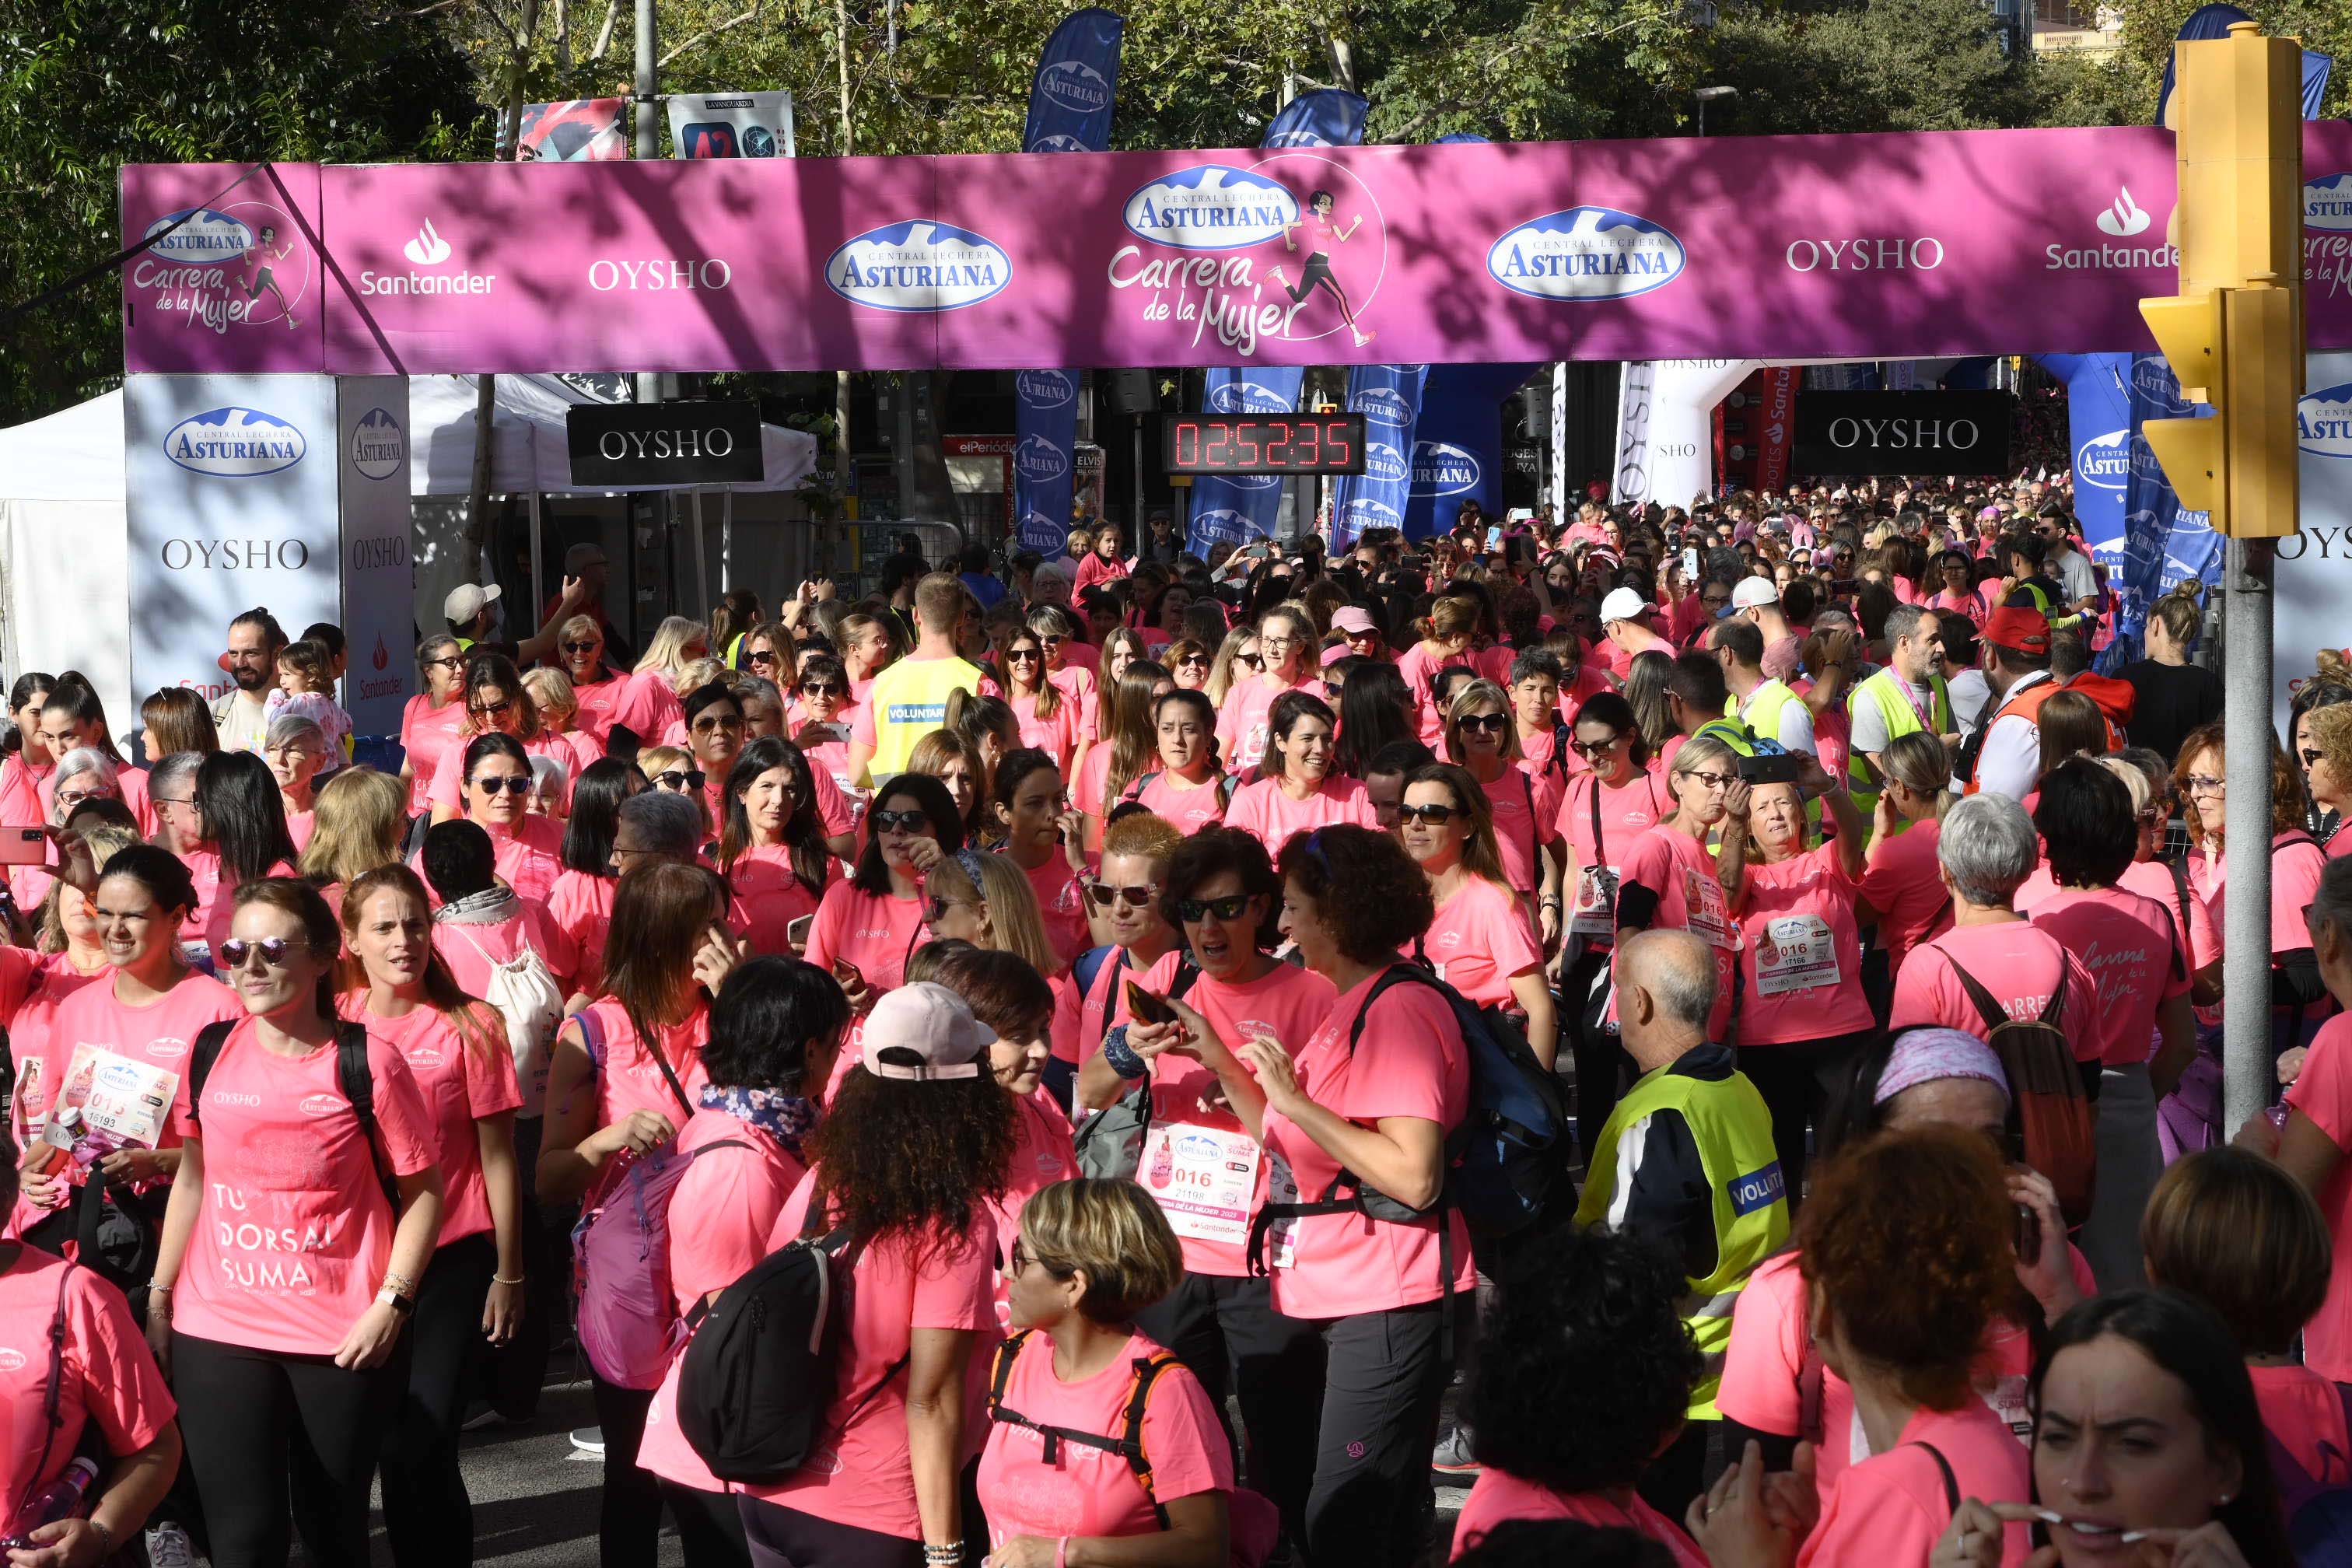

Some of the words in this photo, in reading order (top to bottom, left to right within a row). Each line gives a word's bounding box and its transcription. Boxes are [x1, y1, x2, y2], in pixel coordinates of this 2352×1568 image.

[1163, 194, 1220, 204] CENTRAL
[1224, 193, 1281, 202] LECHERA
[1137, 197, 1286, 229] ASTURIANA
[152, 229, 245, 250] ASTURIANA
[1533, 239, 1592, 250] CENTRAL
[1600, 236, 1664, 248] LECHERA
[868, 250, 927, 261] CENTRAL
[933, 250, 991, 261] LECHERA
[1502, 243, 1670, 278] ASTURIANA
[1787, 236, 1944, 271] OYSHO
[134, 260, 225, 289] Carrera
[588, 257, 732, 292] OYSHO
[841, 255, 998, 290] ASTURIANA
[1108, 245, 1254, 289] Carrera
[2317, 258, 2333, 281] la
[360, 270, 496, 296] Santander
[156, 290, 173, 310] de
[176, 290, 189, 310] la
[186, 285, 261, 335] Mujer
[1143, 289, 1171, 322] de
[1177, 289, 1196, 321] la
[1191, 278, 1309, 356] Mujer
[175, 433, 297, 460] ASTURIANA
[599, 427, 734, 460] OYSHO
[1176, 422, 1349, 465] 02:52:35
[1828, 417, 1979, 450] OYSHO
[355, 436, 401, 463] ASTURIANA
[1076, 456, 1102, 467] ELVIS
[1657, 443, 1696, 457] SHO
[161, 538, 310, 571] OYSHO
[352, 535, 405, 571] OYSHO
[359, 677, 404, 701] Santander
[1831, 747, 1845, 761] TU
[1703, 901, 1723, 916] 016
[1776, 926, 1805, 938] ASTURIANA
[1780, 943, 1808, 957] 016
[1785, 956, 1806, 967] 17166
[213, 1091, 261, 1108] OYSHO
[88, 1111, 116, 1128] 16193
[1175, 1167, 1212, 1188] 016
[212, 1183, 247, 1211] TU
[1175, 1188, 1205, 1201] 21198
[1195, 1206, 1220, 1216] MUJER
[220, 1223, 336, 1254] DORSAL
[1199, 1222, 1237, 1234] Santander
[220, 1257, 312, 1288] SUMA
